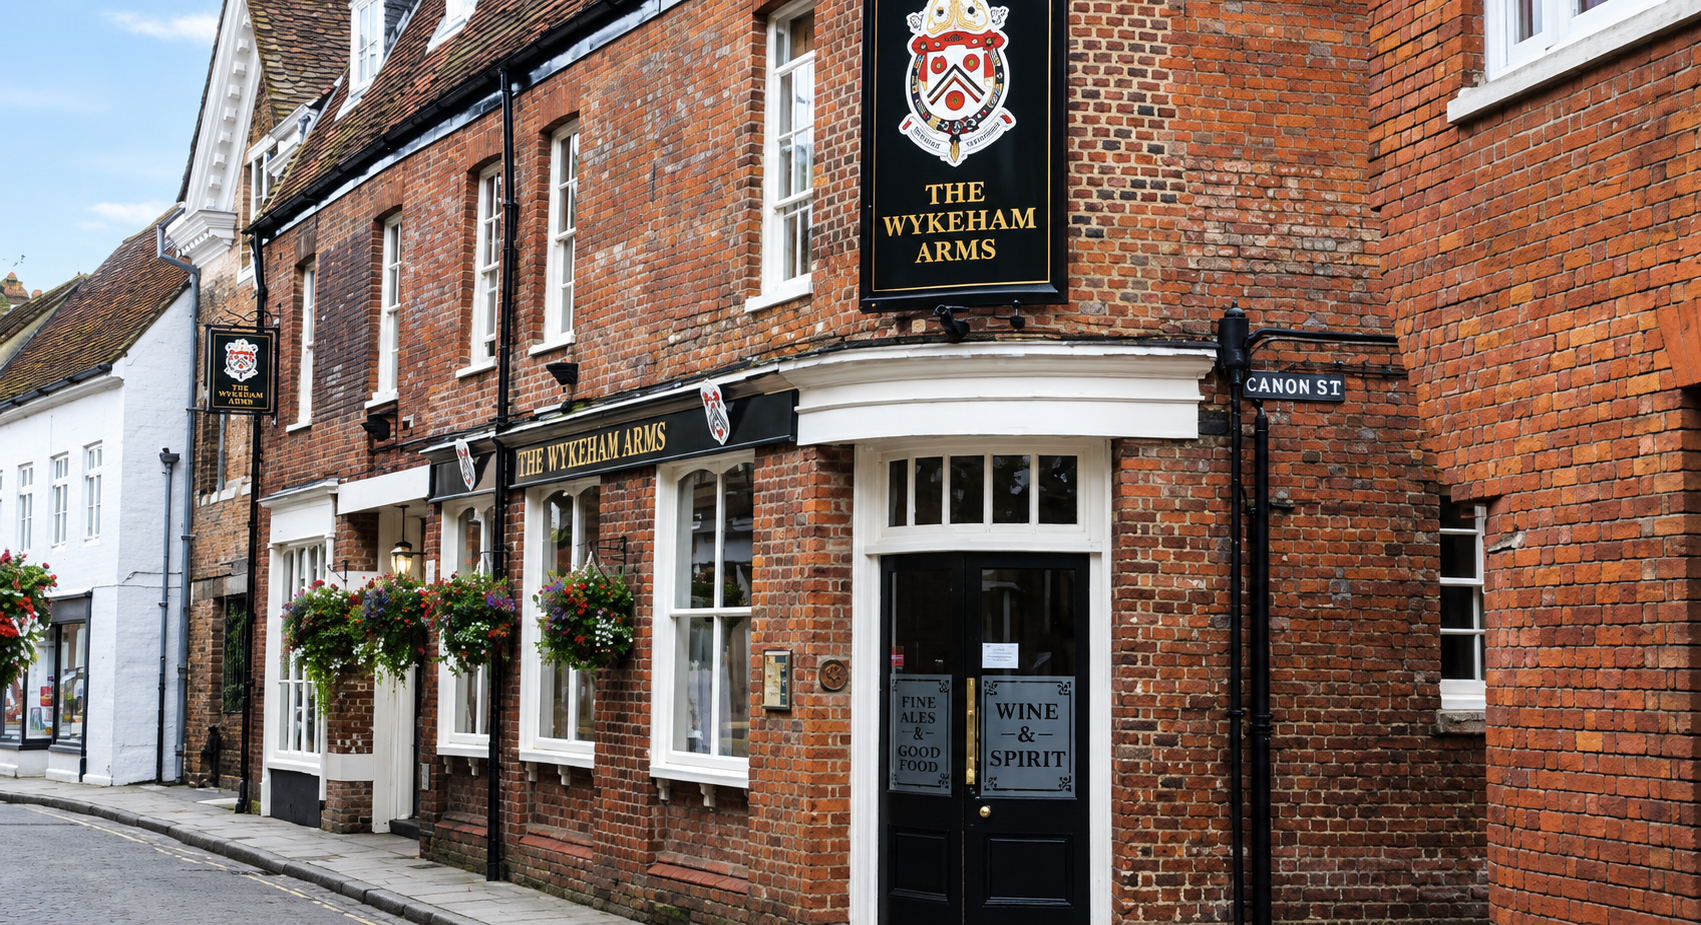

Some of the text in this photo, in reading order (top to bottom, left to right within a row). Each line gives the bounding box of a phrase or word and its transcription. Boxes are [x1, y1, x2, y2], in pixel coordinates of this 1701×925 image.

[925, 181, 986, 206] THE
[882, 207, 1037, 237] WYKEHAM
[914, 238, 997, 264] ARMS
[1246, 376, 1342, 396] CANON ST
[517, 421, 667, 478] THE WYKEHAM ARMS
[902, 696, 937, 709] FINE
[995, 702, 1060, 720] WINE
[900, 711, 936, 724] ALES
[898, 744, 941, 759] GOOD
[989, 750, 1067, 768] SPIRIT
[899, 759, 939, 773] FOOD
